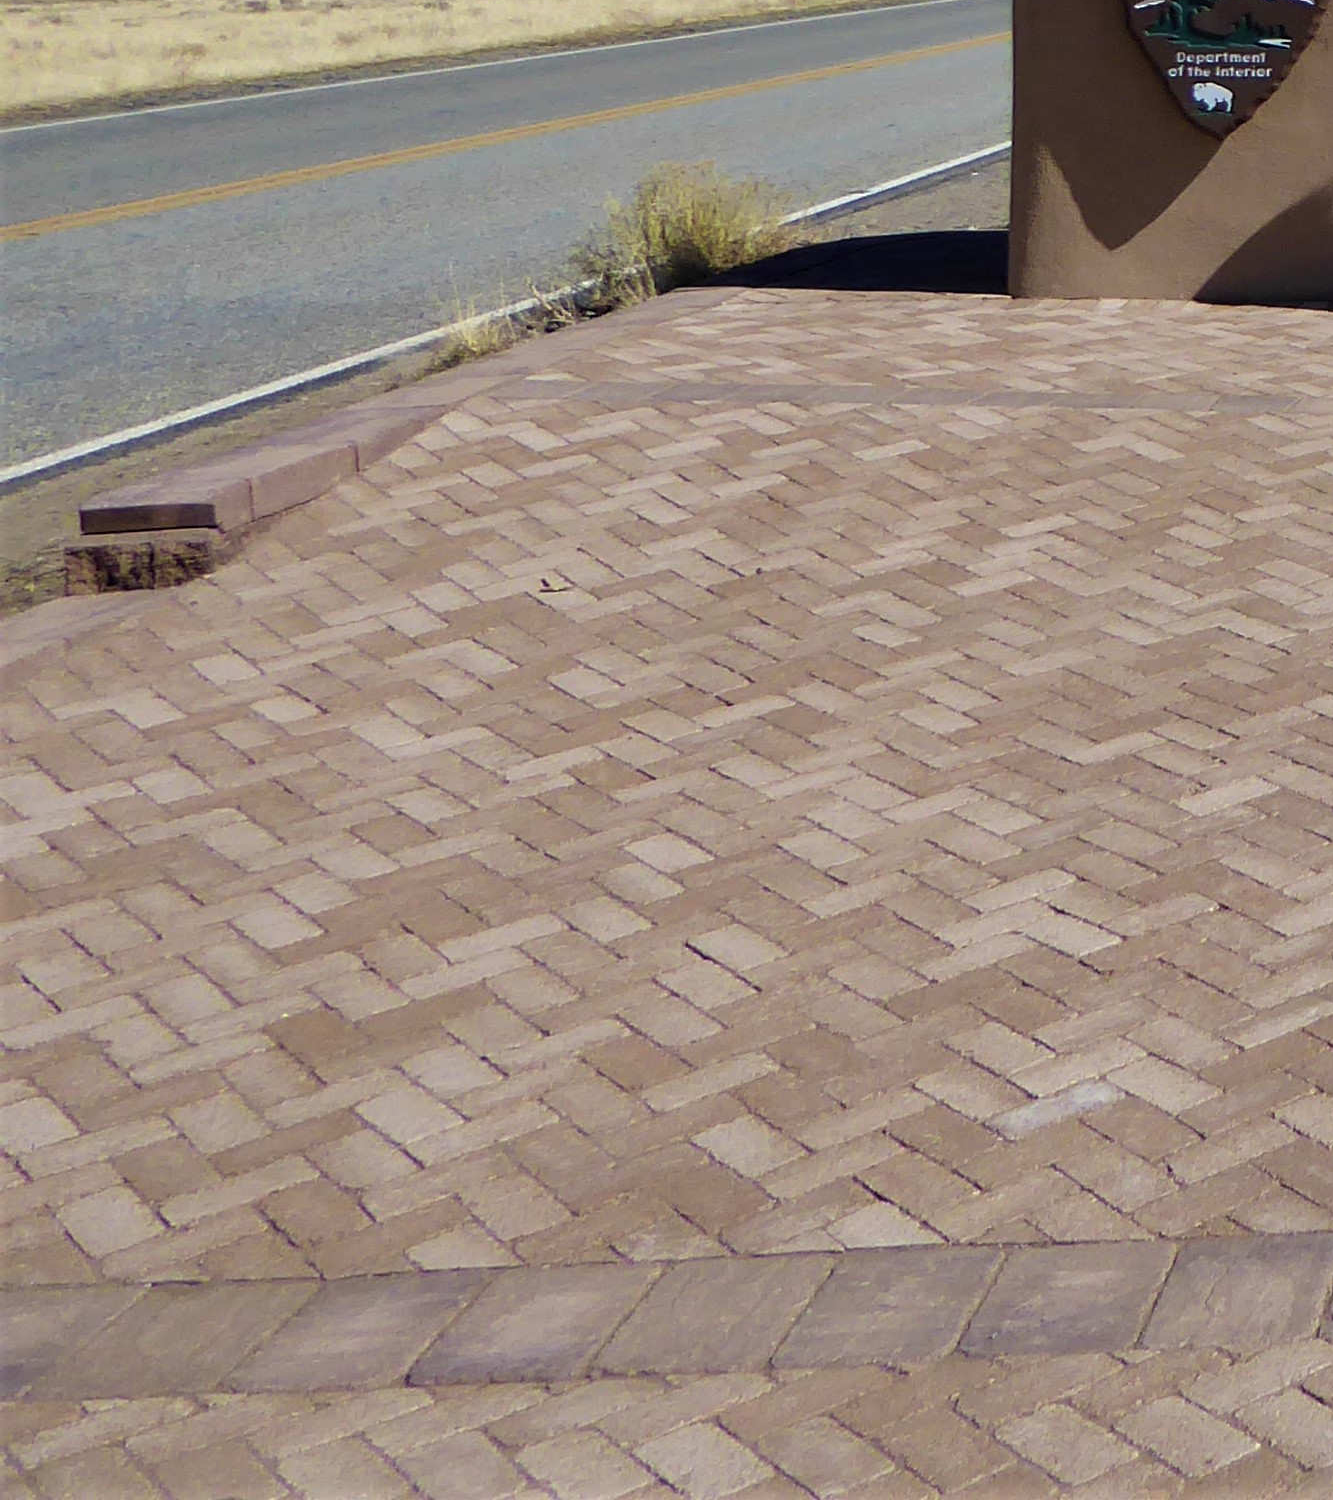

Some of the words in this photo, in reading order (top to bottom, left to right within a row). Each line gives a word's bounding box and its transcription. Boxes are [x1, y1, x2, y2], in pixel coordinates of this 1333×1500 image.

[1176, 51, 1266, 65] Department
[1168, 64, 1184, 77] of
[1188, 65, 1211, 78] the
[1215, 65, 1273, 78] Interior
